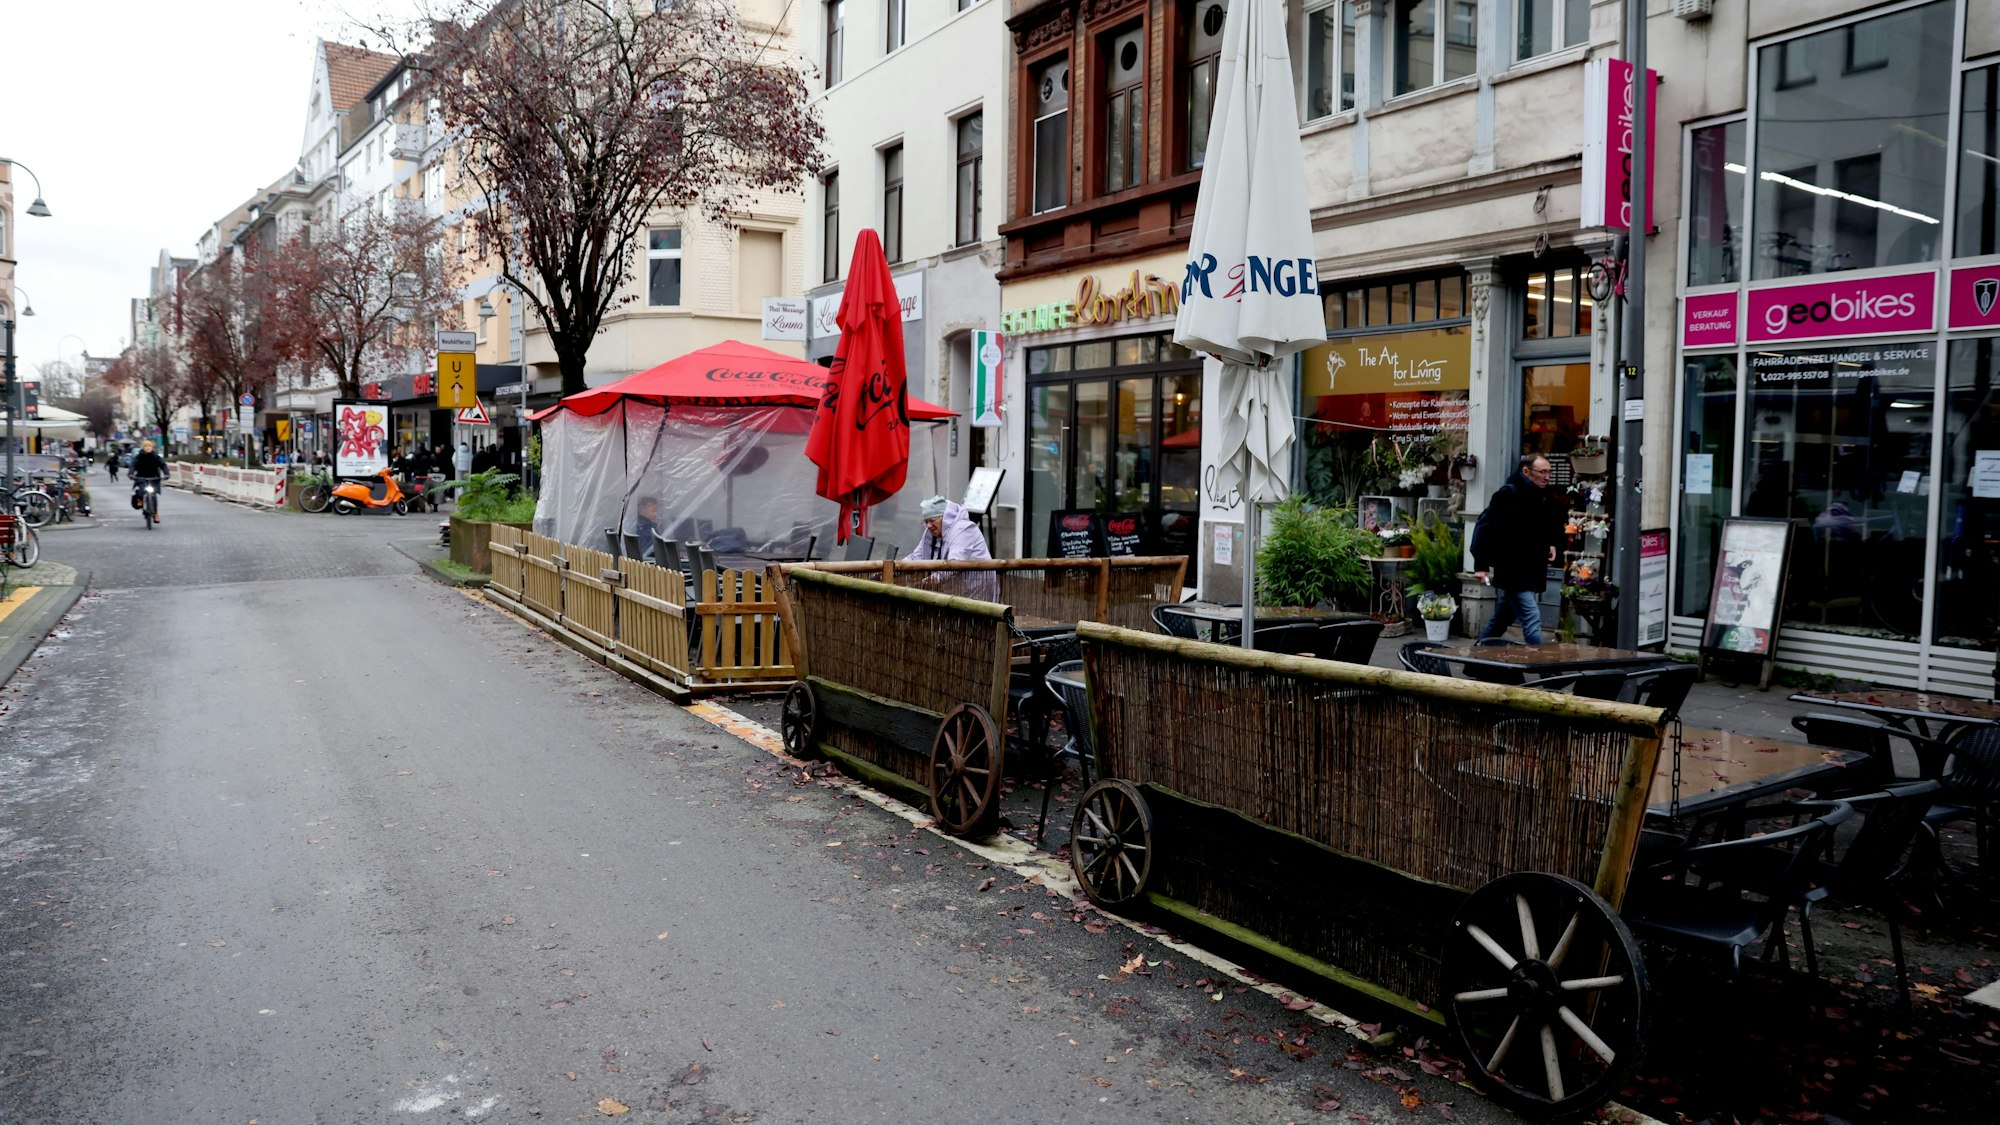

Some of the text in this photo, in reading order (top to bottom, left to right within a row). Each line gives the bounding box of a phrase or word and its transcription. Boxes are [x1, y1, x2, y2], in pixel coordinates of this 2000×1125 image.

[1247, 255, 1321, 298] NGE
[782, 306, 805, 315] Massage
[1692, 308, 1729, 319] VERKAUF
[1765, 290, 1916, 334] geobikes
[766, 314, 804, 333] Lanna
[1689, 321, 1732, 332] BERATUNG
[1358, 346, 1399, 367] The Art
[1752, 348, 1929, 367] FAHRRADEINZELHANDEL & SERVICE
[1393, 359, 1442, 381] for Living
[1627, 367, 1637, 376] 12
[1836, 367, 1910, 379] www.geobikes.de
[1392, 400, 1420, 410] Konzepte
[1421, 399, 1430, 408] für
[1411, 411, 1422, 419] und
